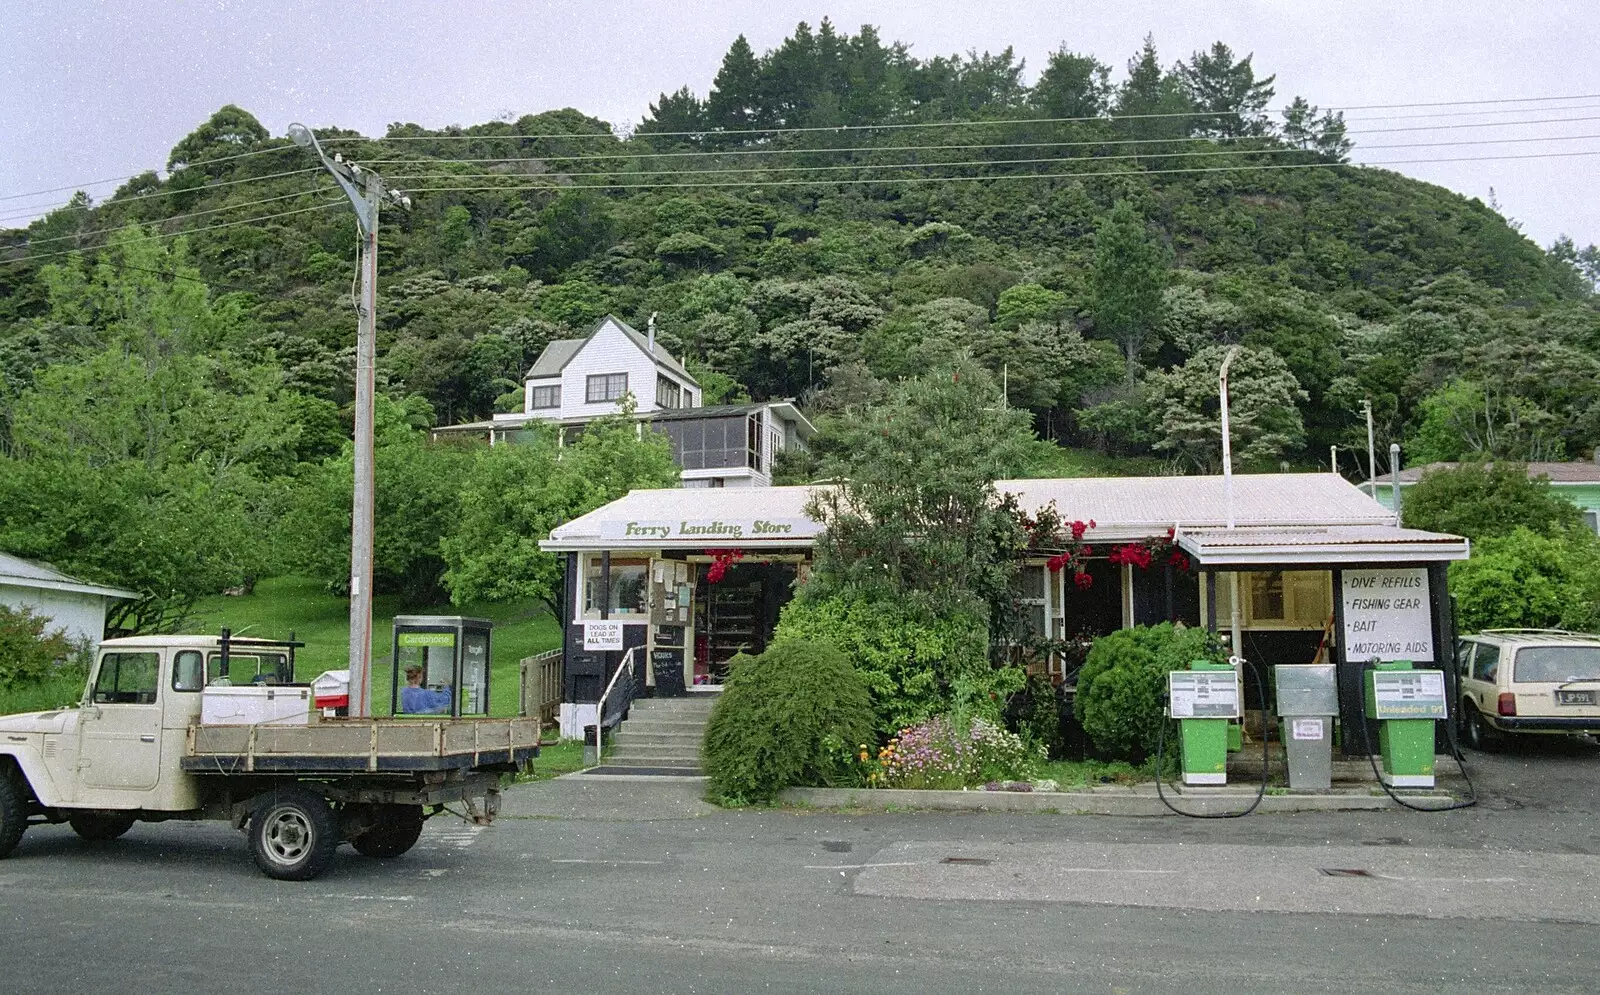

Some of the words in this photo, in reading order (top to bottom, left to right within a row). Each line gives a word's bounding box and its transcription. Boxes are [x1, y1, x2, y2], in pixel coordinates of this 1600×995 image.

[625, 521, 671, 539] Ferry
[679, 521, 743, 539] Landing
[751, 519, 792, 535] Store
[1351, 577, 1376, 589] DIVE
[1381, 576, 1421, 588] REFILLS
[1352, 598, 1390, 610] FISHING
[1393, 598, 1421, 610] GEAR
[1353, 620, 1377, 632] BAIT
[404, 634, 450, 644] Cardphone
[1352, 642, 1401, 654] MOTORING
[1404, 642, 1428, 653] AIDS
[1379, 704, 1427, 714] Unleaded
[1431, 705, 1443, 714] 91
